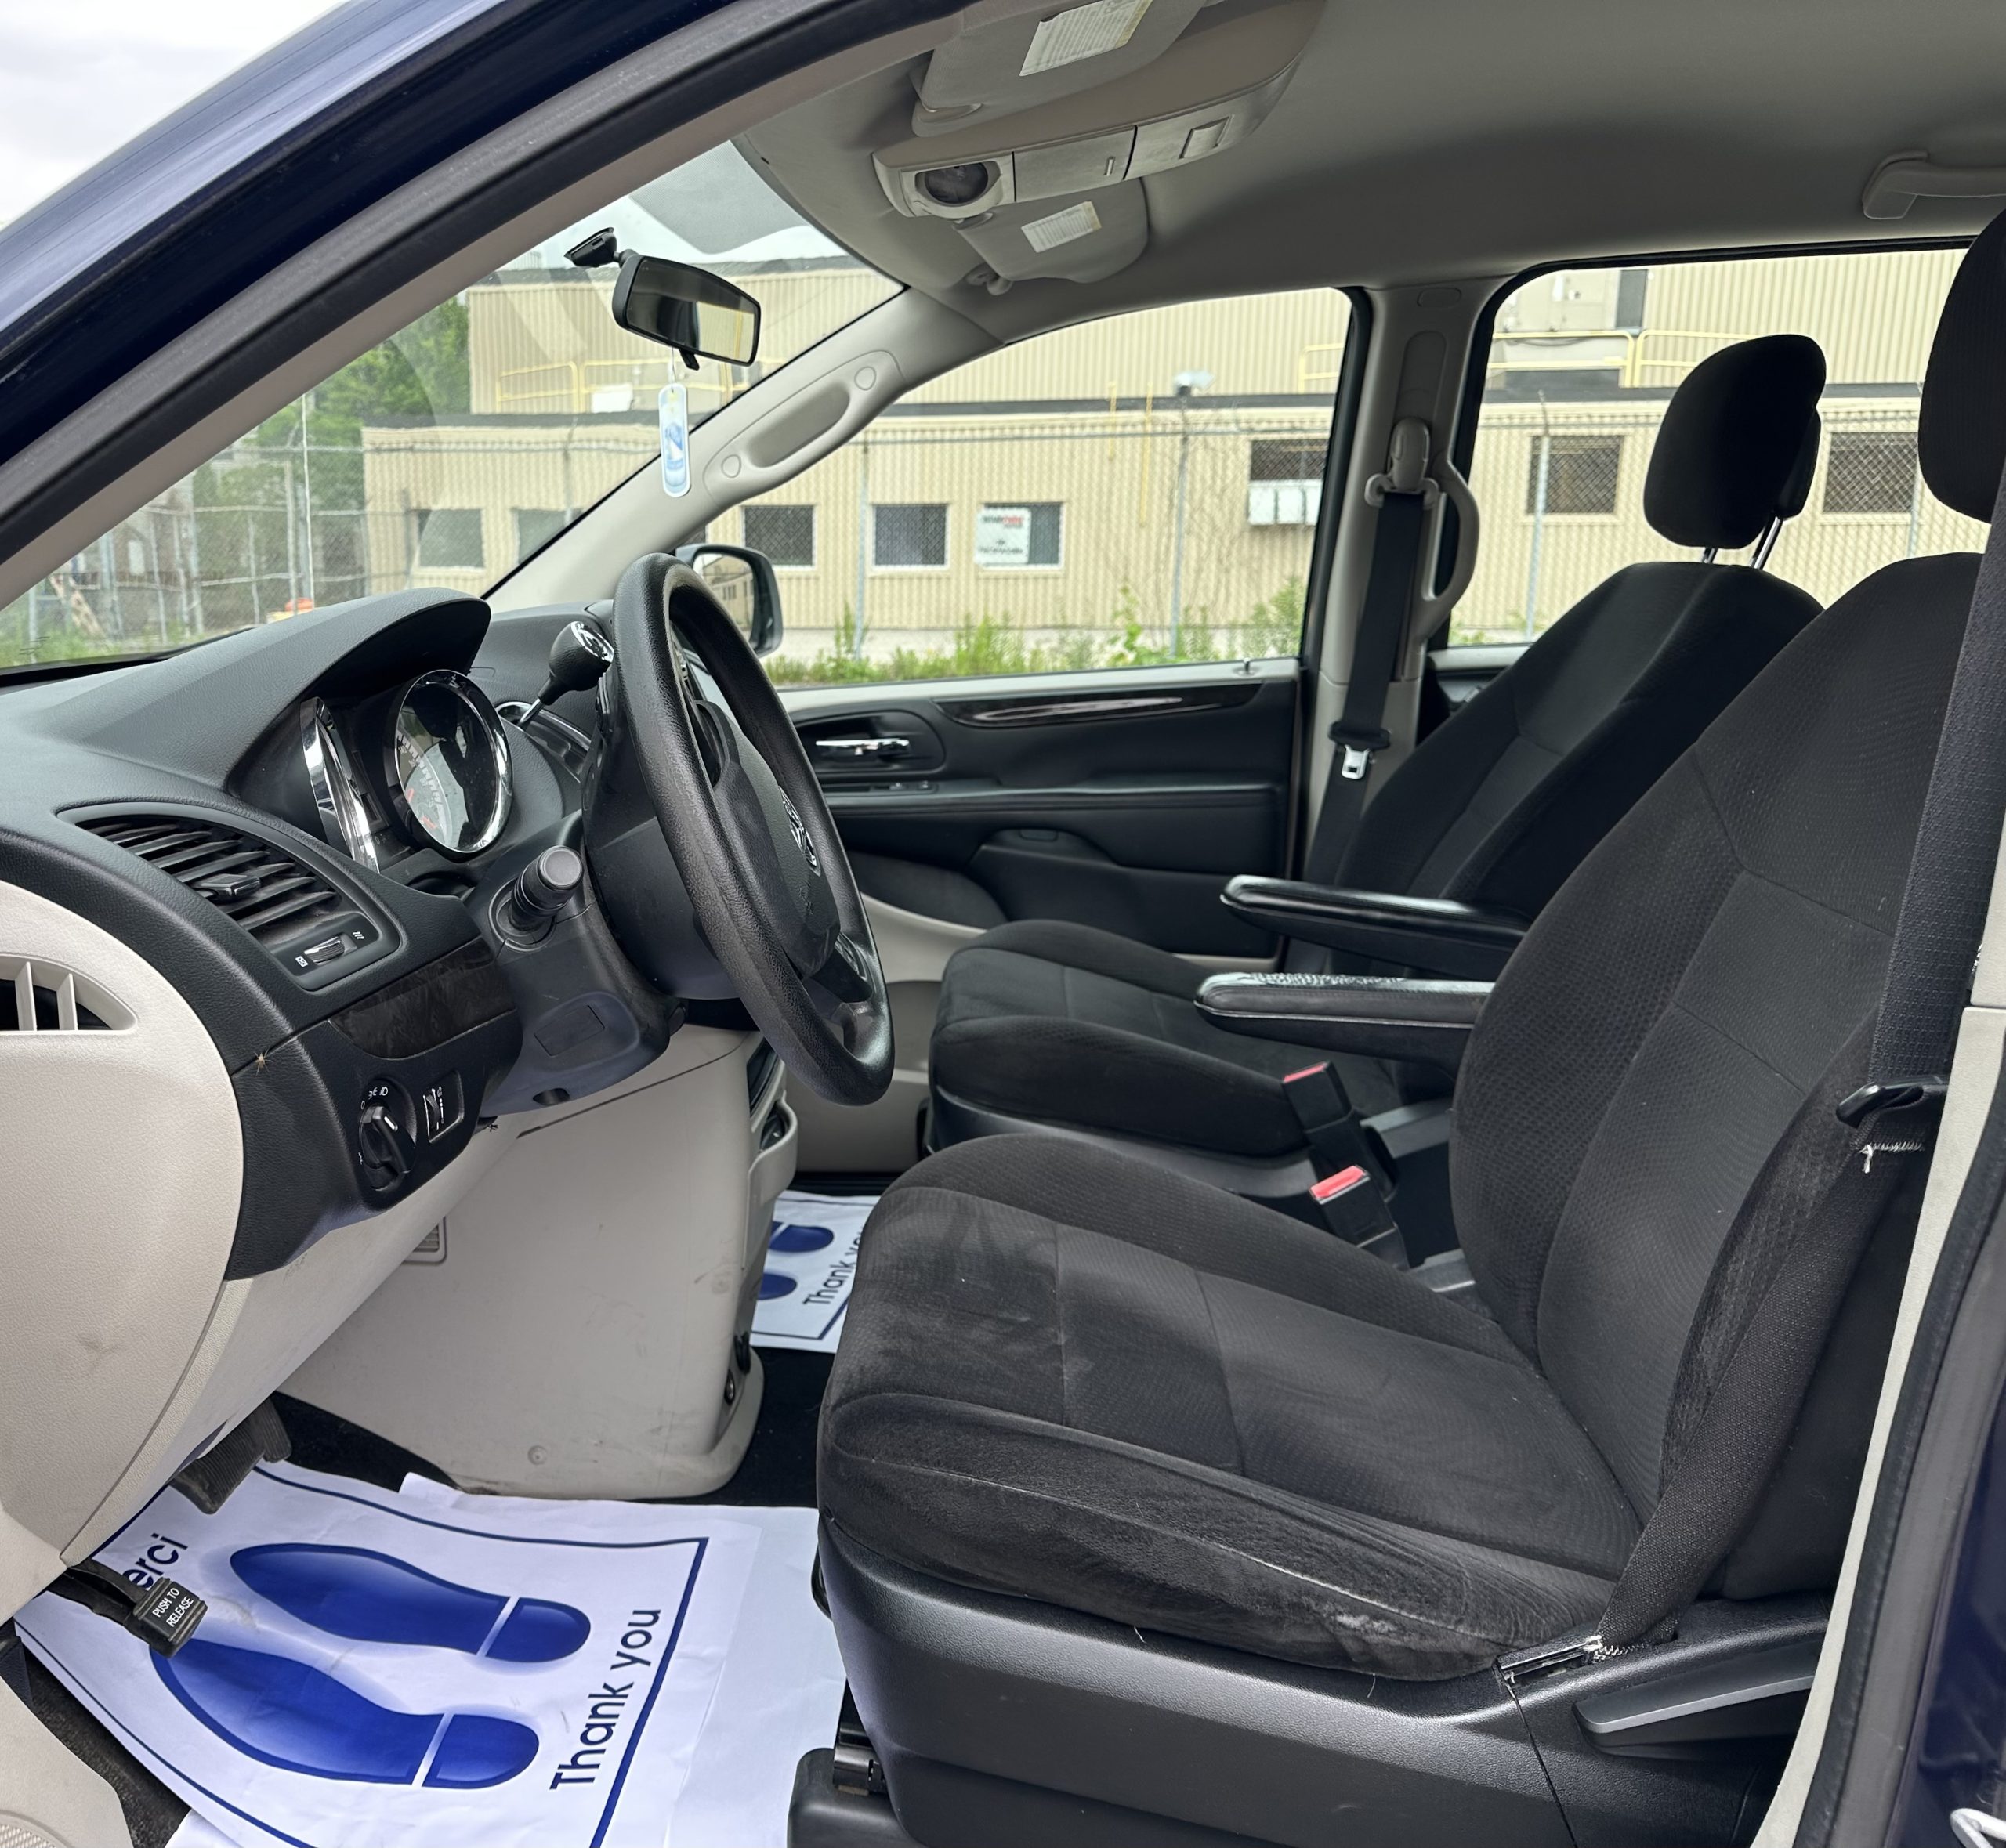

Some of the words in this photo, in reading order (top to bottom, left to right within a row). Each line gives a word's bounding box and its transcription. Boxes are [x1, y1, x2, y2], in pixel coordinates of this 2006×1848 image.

[802, 1260, 856, 1305] Thank
[122, 1532, 188, 1590] erci
[152, 1597, 172, 1618] PUSH
[167, 1587, 180, 1599] TO
[165, 1596, 194, 1627] RELEASE
[549, 1682, 635, 1790] Thank
[610, 1609, 661, 1670] you
